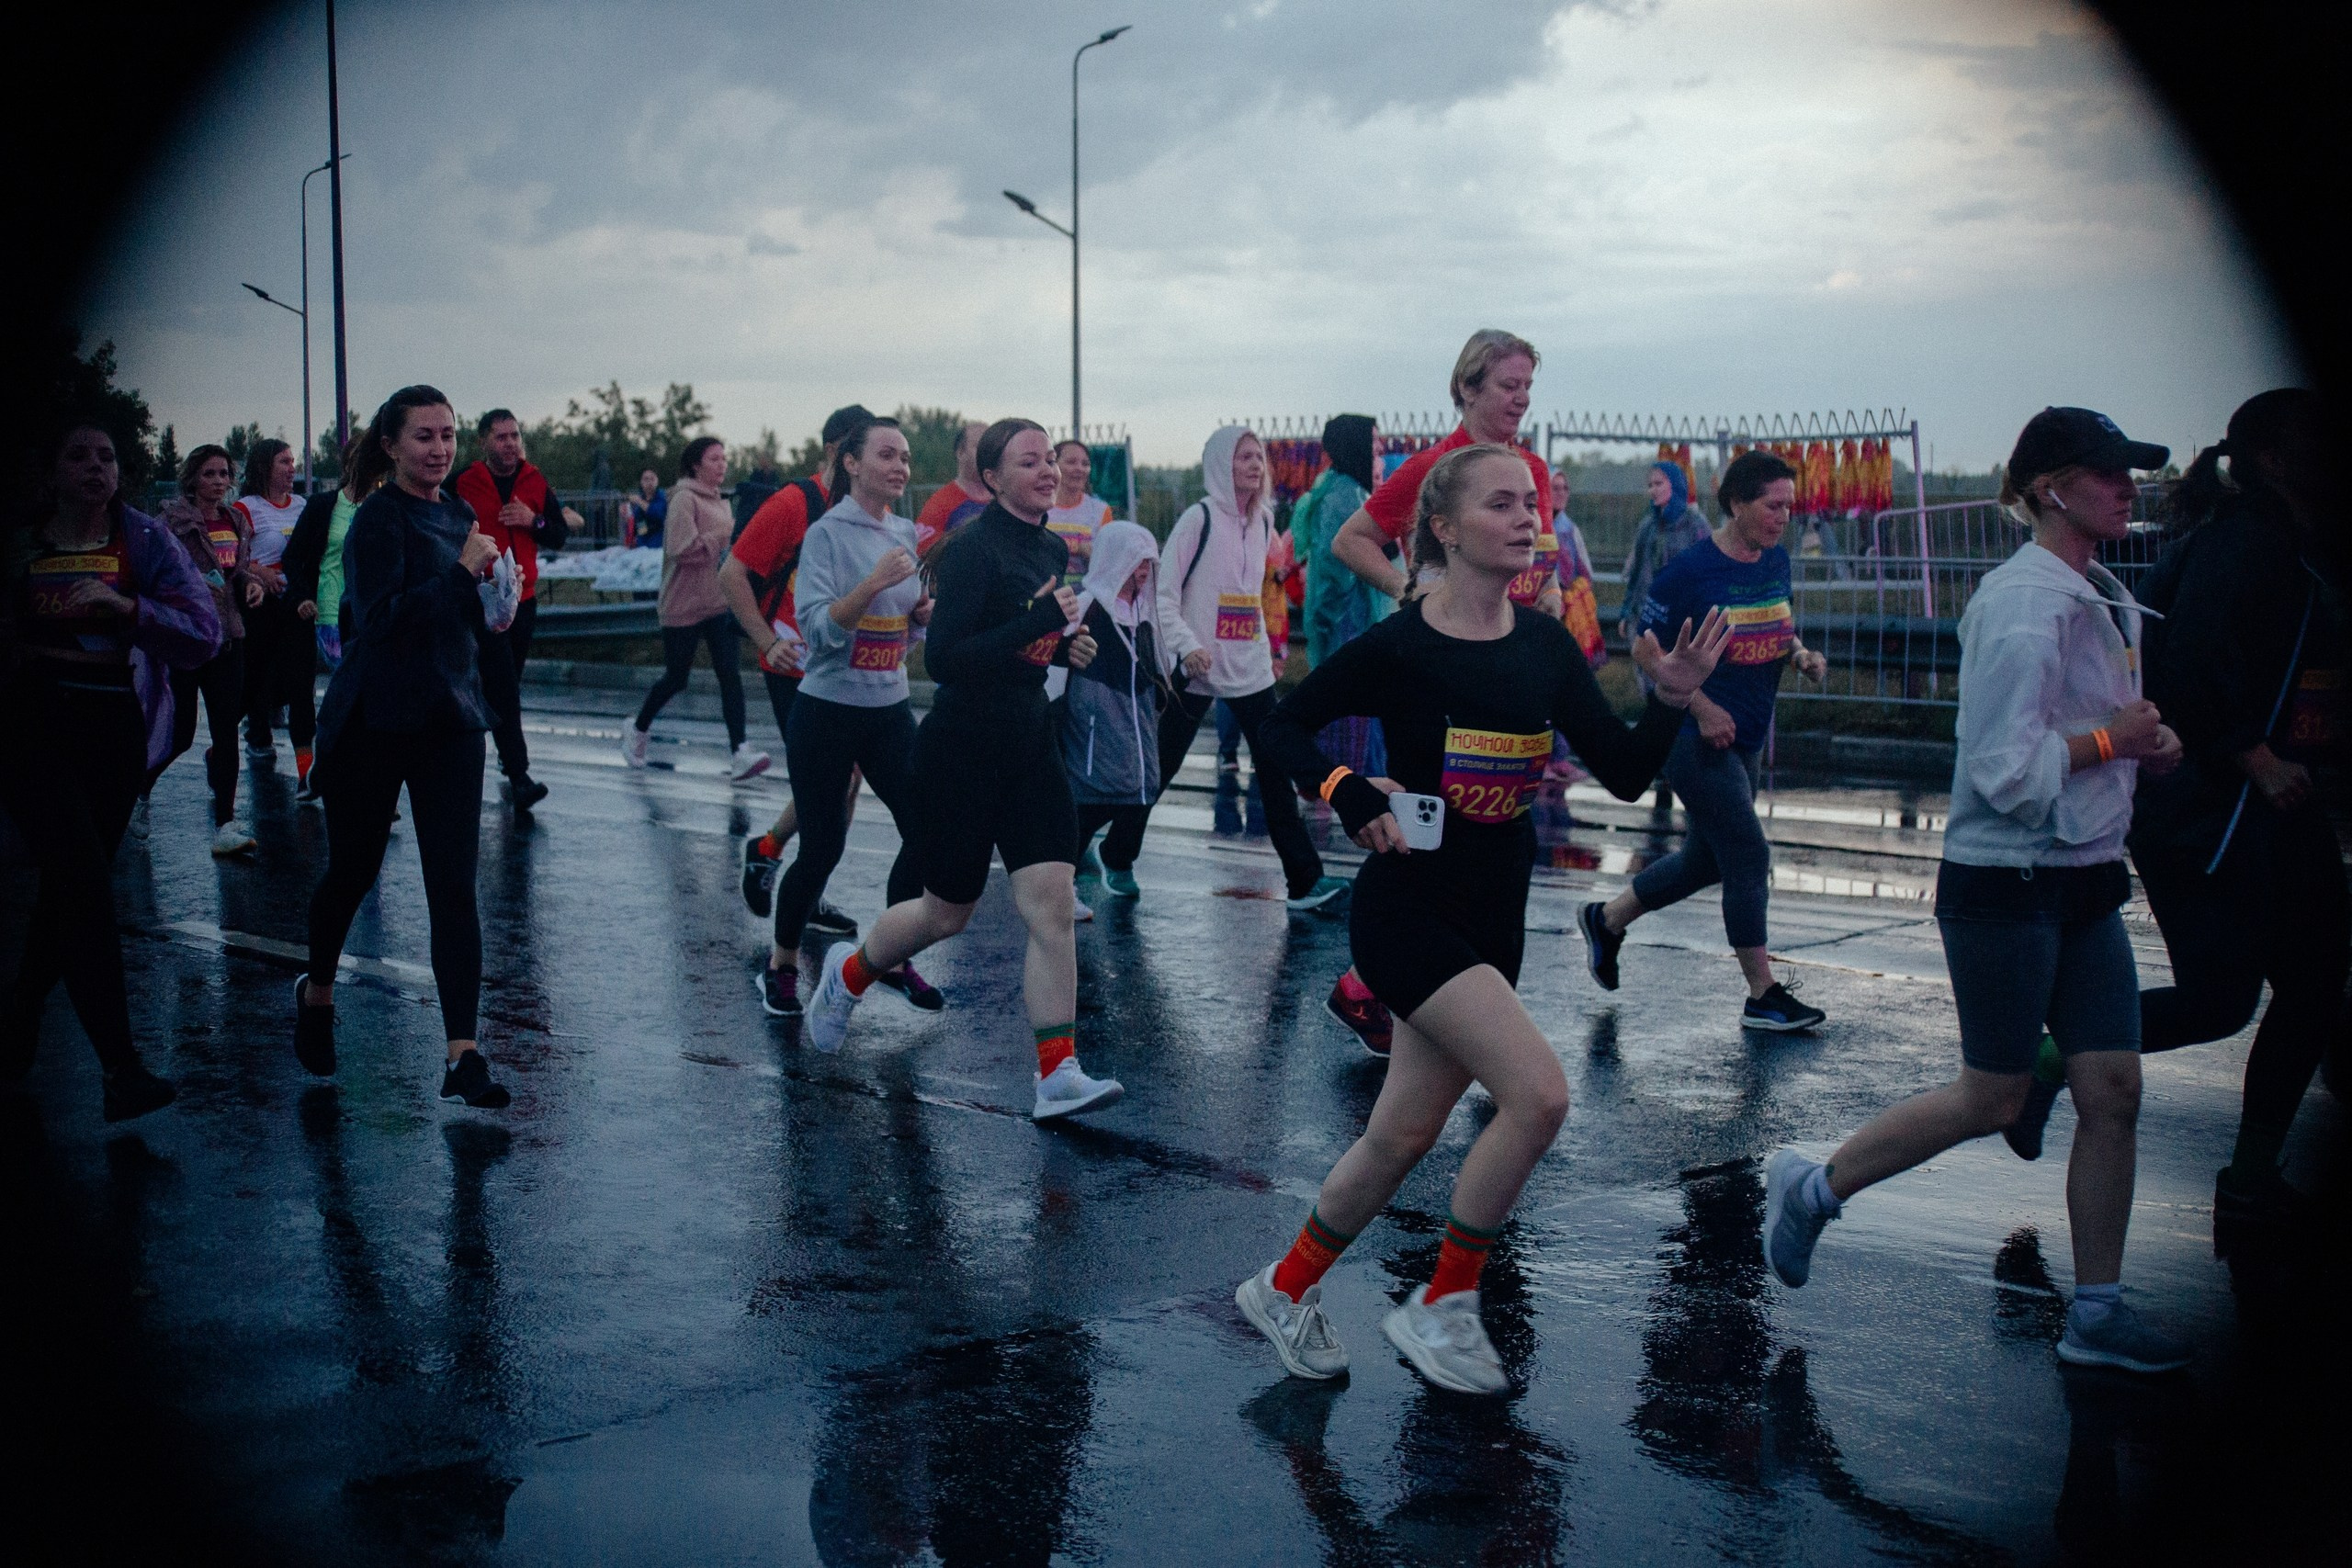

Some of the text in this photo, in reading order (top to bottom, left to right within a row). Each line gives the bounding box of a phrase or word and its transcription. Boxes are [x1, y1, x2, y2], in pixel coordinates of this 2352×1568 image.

[855, 646, 899, 668] 2301
[1730, 637, 1779, 661] 2365
[1452, 733, 1514, 753] НОЧНОЙ
[1447, 783, 1518, 817] 3226
